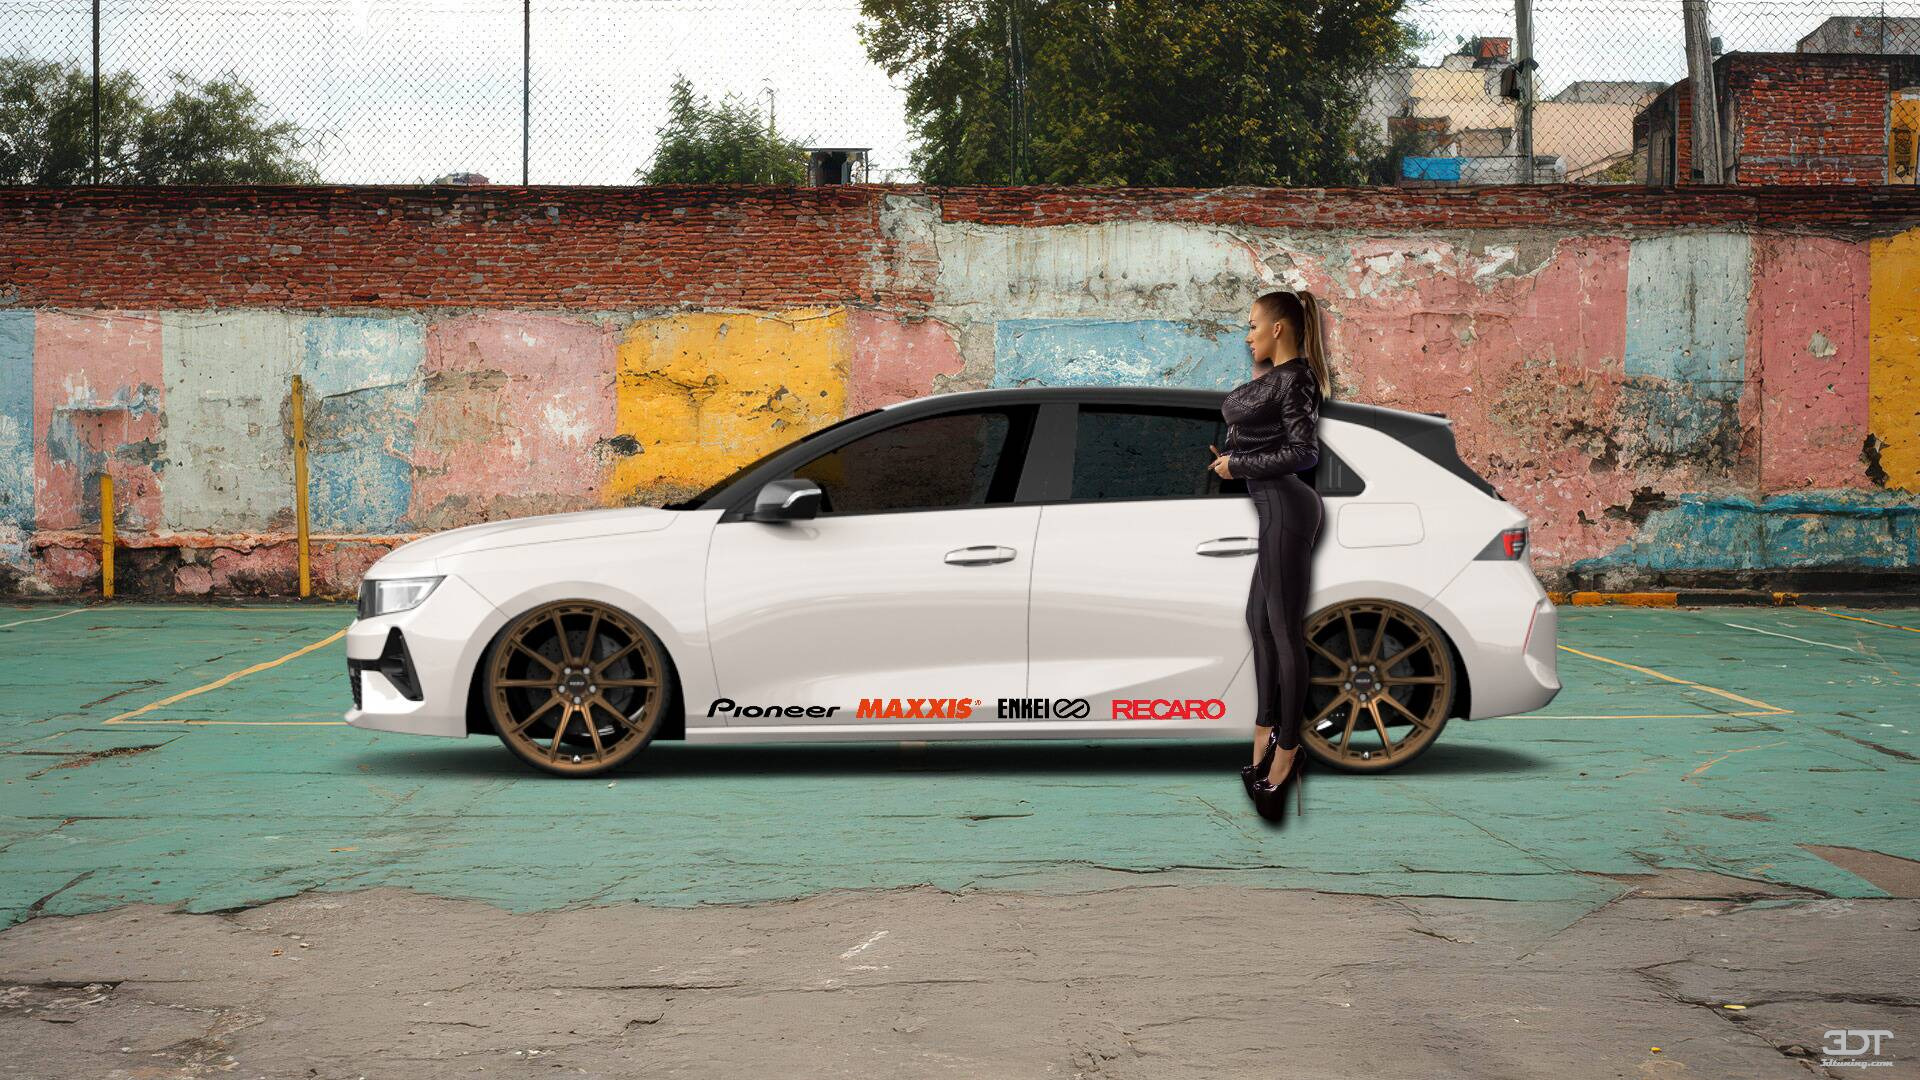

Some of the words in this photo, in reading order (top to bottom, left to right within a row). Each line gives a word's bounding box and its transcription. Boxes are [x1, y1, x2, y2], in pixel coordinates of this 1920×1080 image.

[706, 698, 840, 718] Pioneer
[998, 698, 1050, 719] ENKEI
[1112, 698, 1226, 719] RECARO
